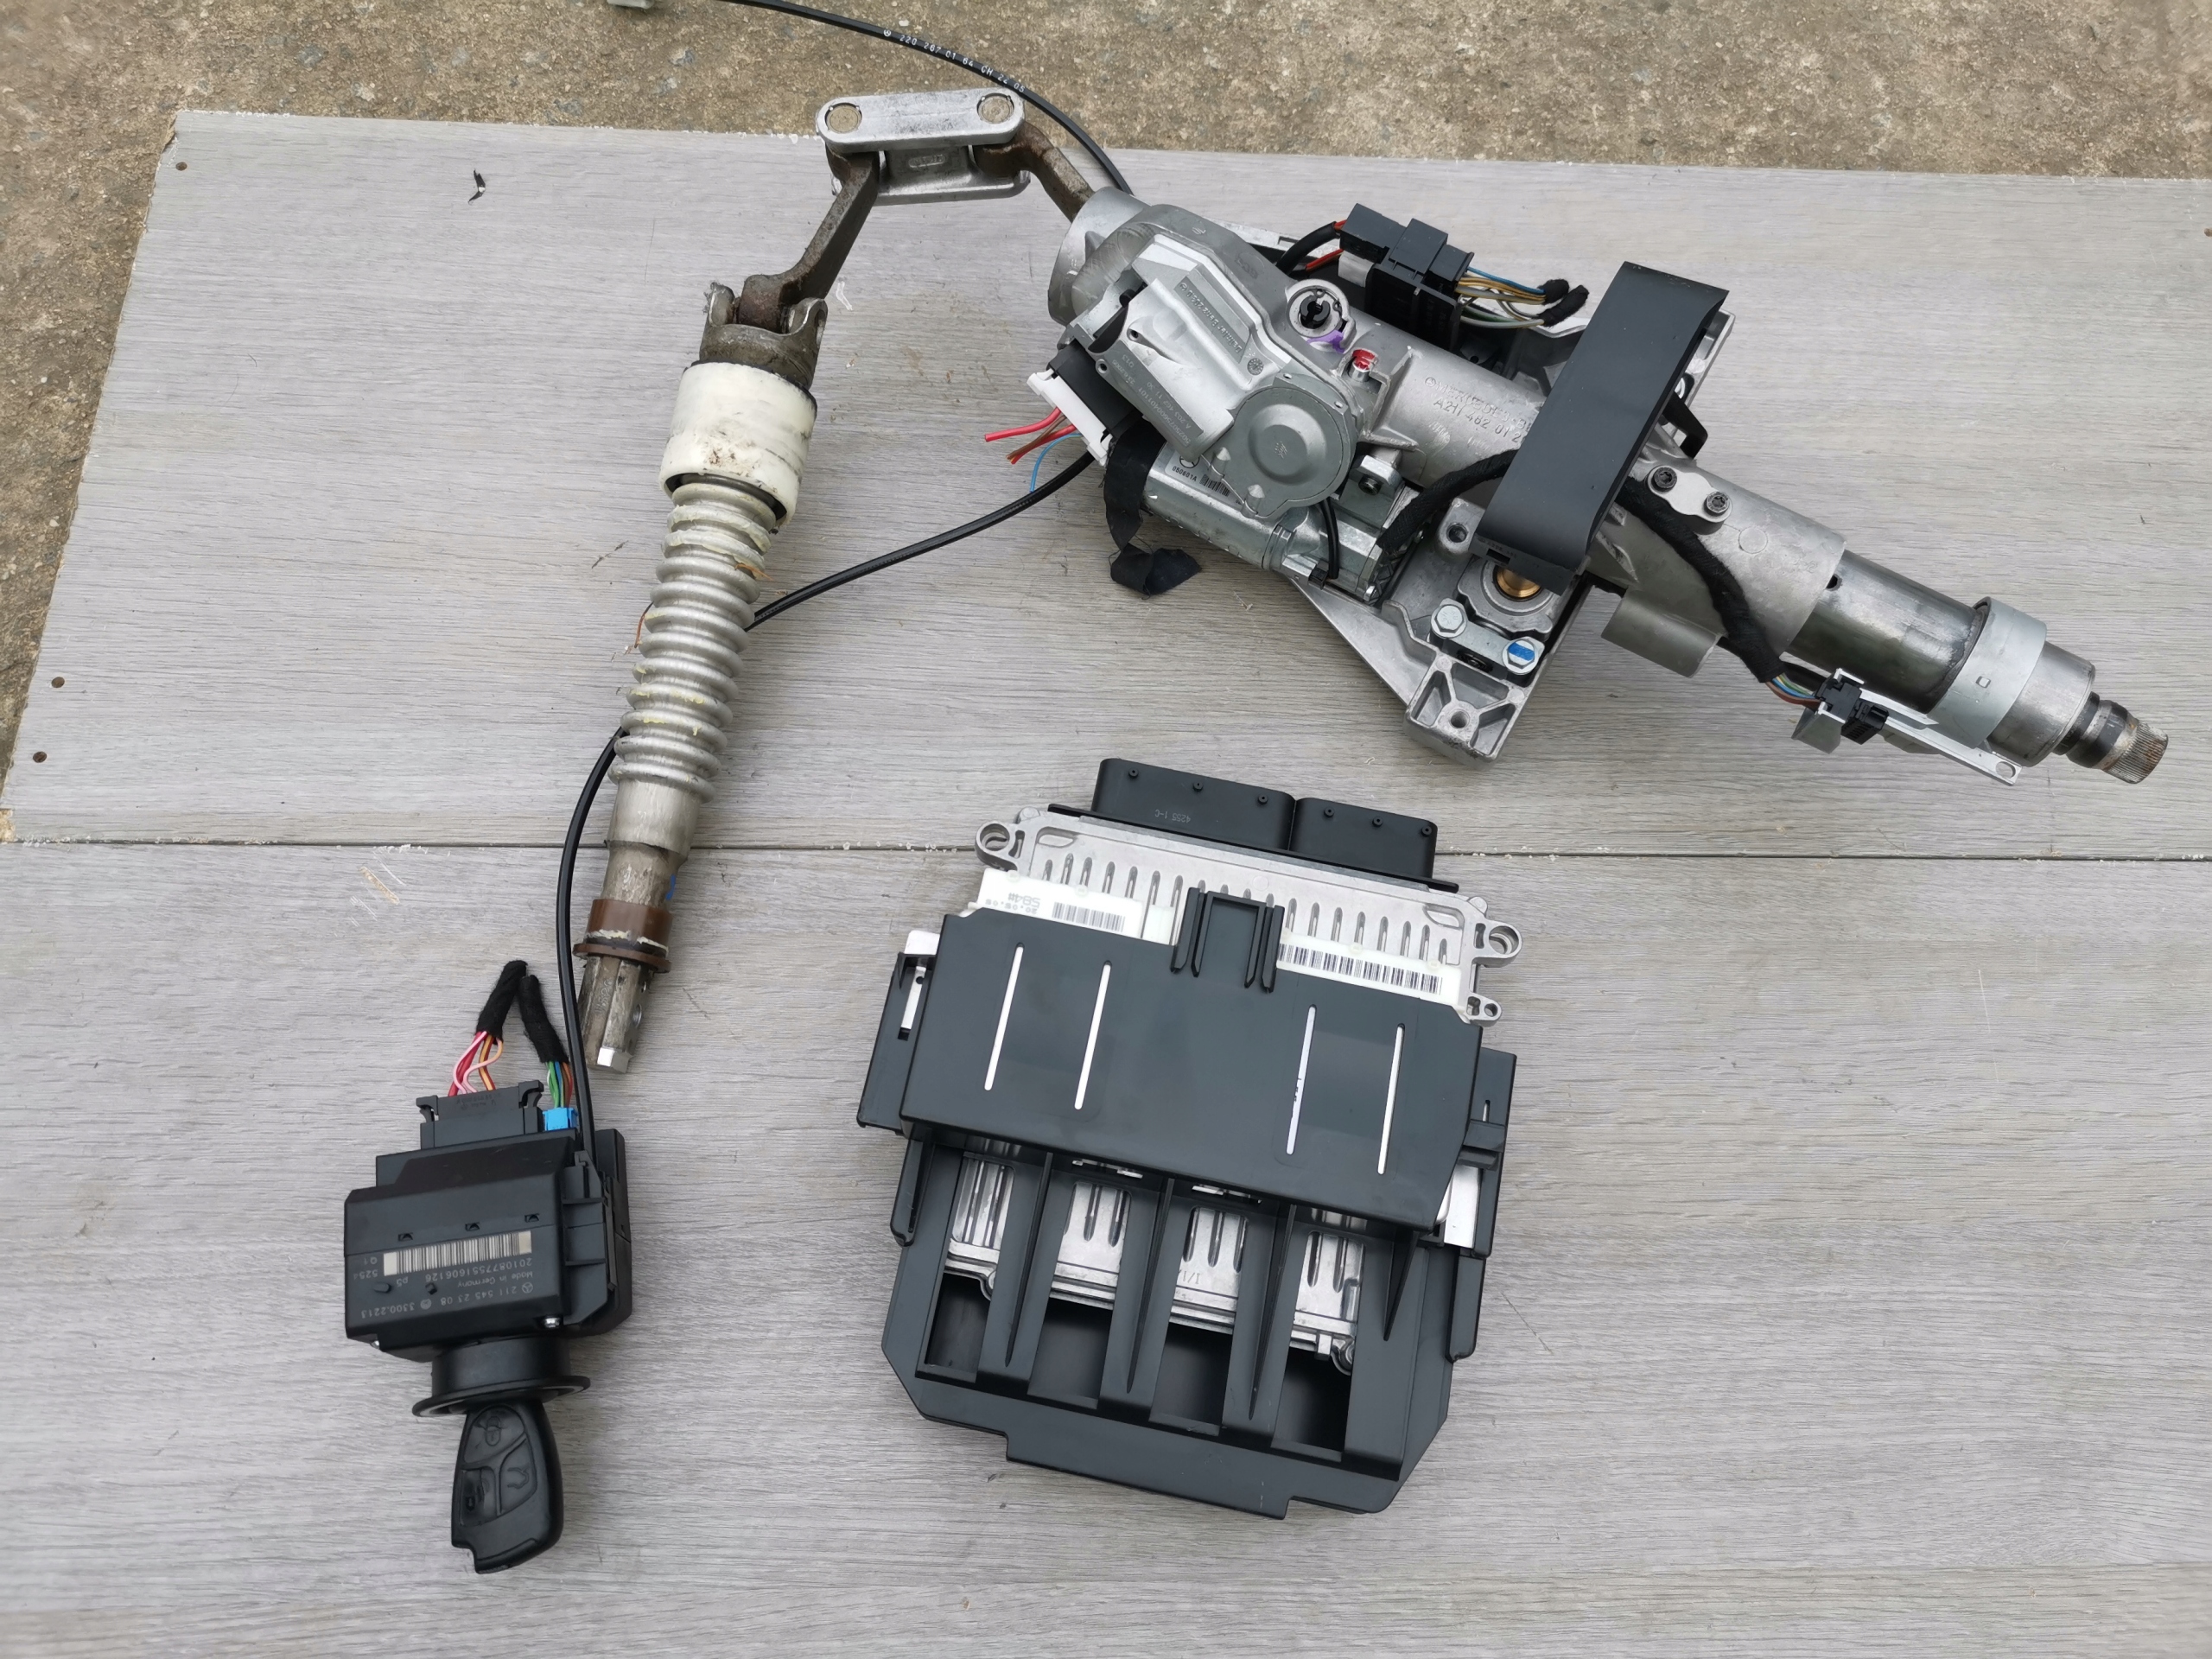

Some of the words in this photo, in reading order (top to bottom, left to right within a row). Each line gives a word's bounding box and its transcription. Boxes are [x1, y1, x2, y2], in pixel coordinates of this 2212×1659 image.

[899, 34, 918, 46] 220
[924, 41, 941, 54] 267
[945, 49, 957, 60] 01
[980, 65, 993, 77] CH
[1014, 82, 1026, 93] 05
[1171, 811, 1191, 823] 4255
[510, 1270, 533, 1281] Made
[456, 1275, 495, 1289] Germany
[474, 1289, 493, 1300] 545
[499, 1285, 518, 1295] 211
[439, 1295, 453, 1306] 08
